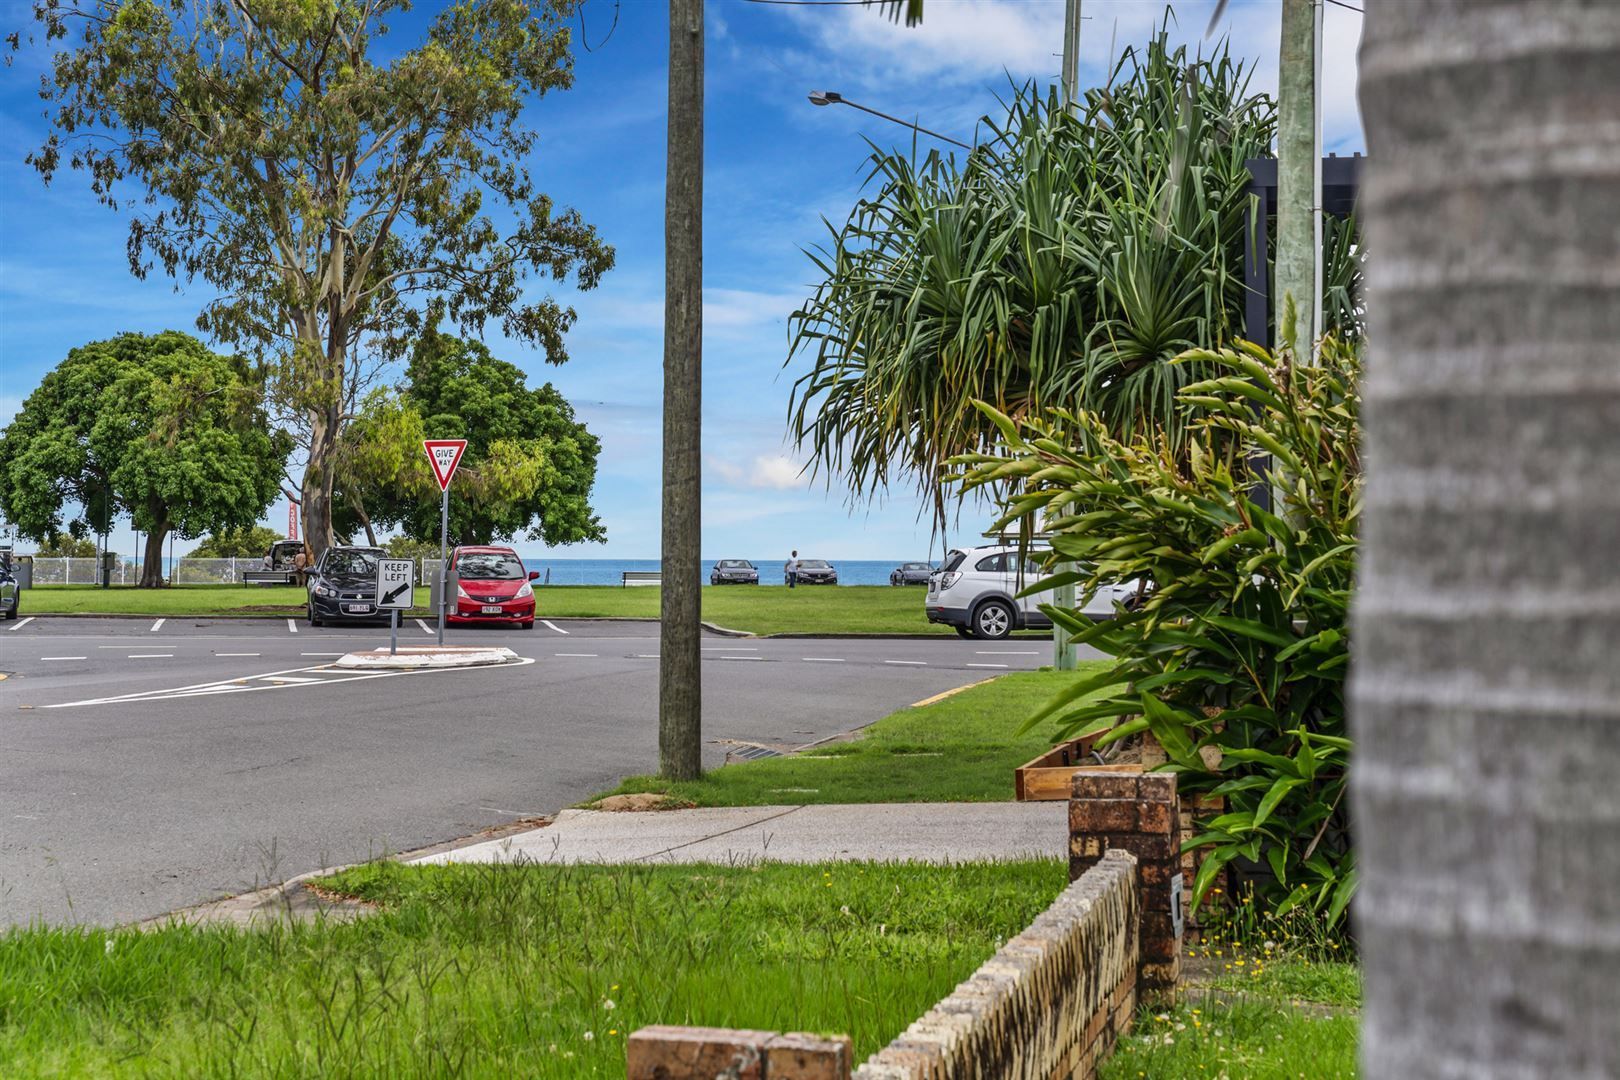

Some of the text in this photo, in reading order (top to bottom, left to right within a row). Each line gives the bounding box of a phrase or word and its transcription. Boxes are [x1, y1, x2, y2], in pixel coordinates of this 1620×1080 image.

[435, 449, 454, 458] GIVE
[384, 563, 409, 572] KEEP
[385, 573, 407, 582] LEFT
